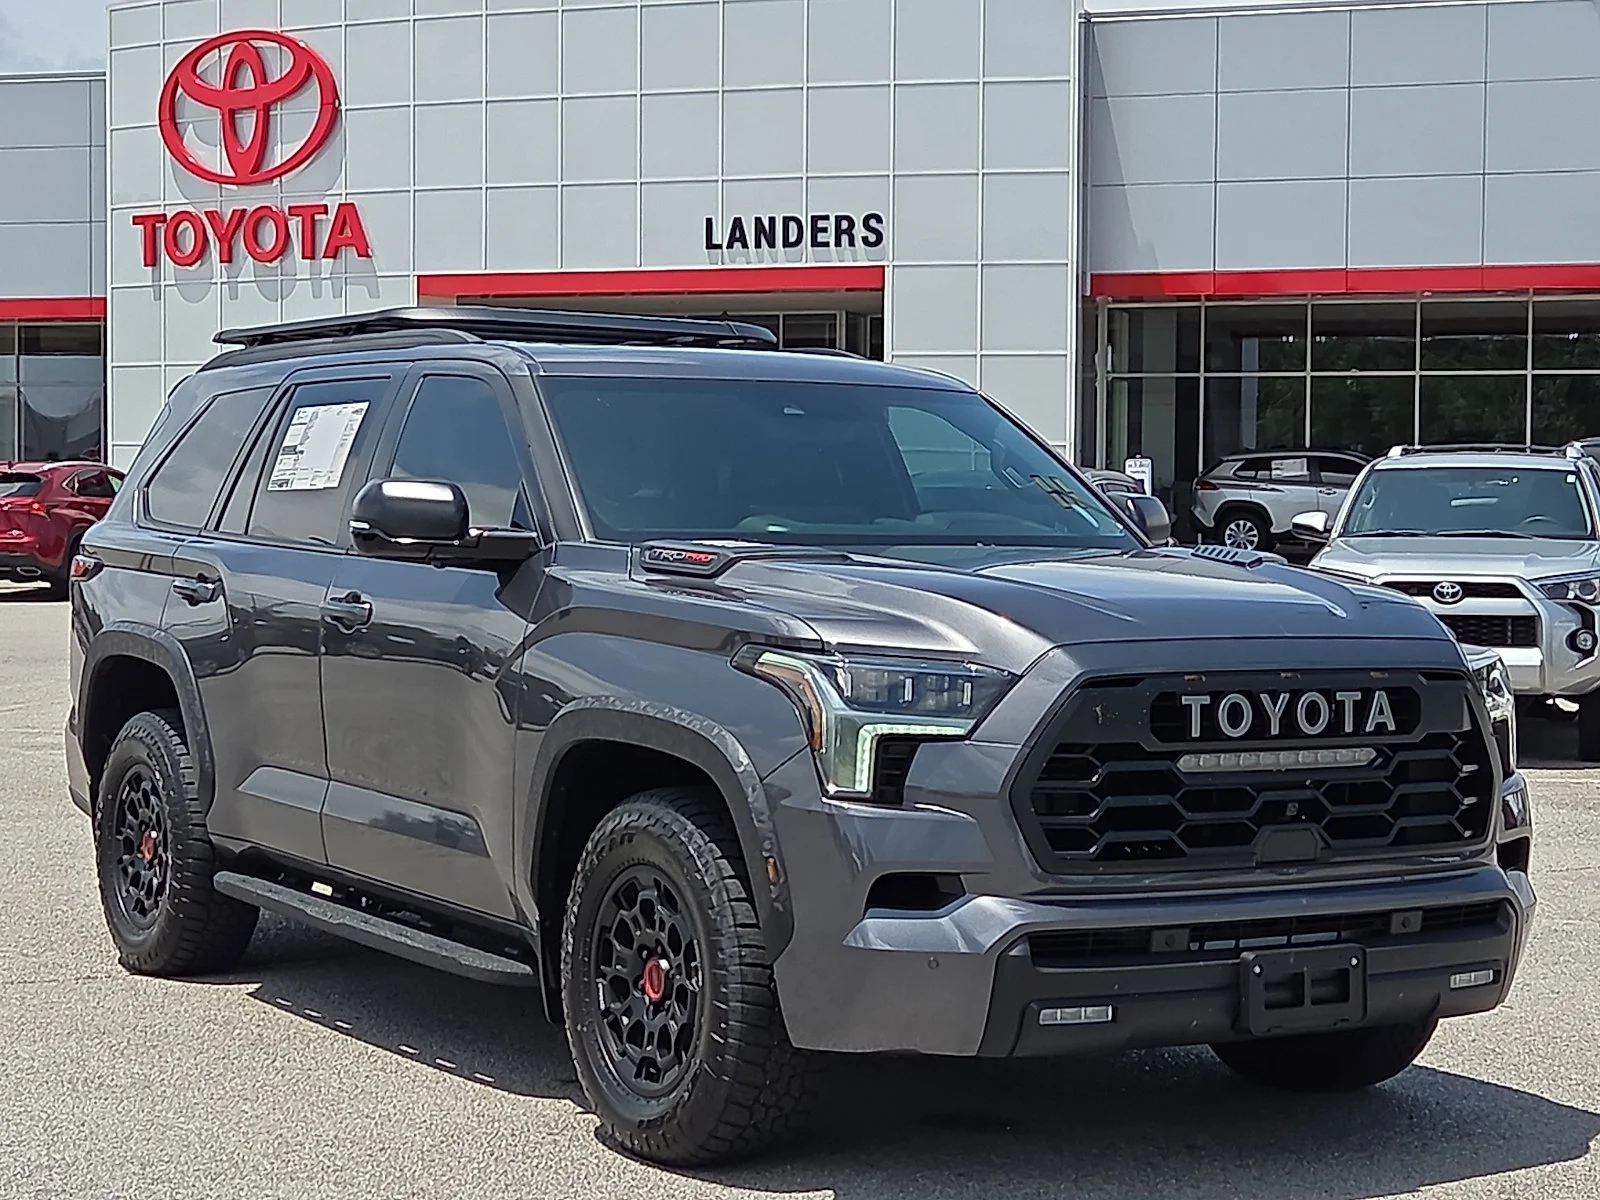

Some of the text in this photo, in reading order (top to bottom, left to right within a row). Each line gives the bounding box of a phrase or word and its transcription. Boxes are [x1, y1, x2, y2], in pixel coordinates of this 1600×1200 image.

[132, 202, 373, 267] TOYOTA
[705, 213, 884, 250] LANDERS
[651, 548, 686, 561] TRD
[1181, 690, 1396, 738] TOYOTA
